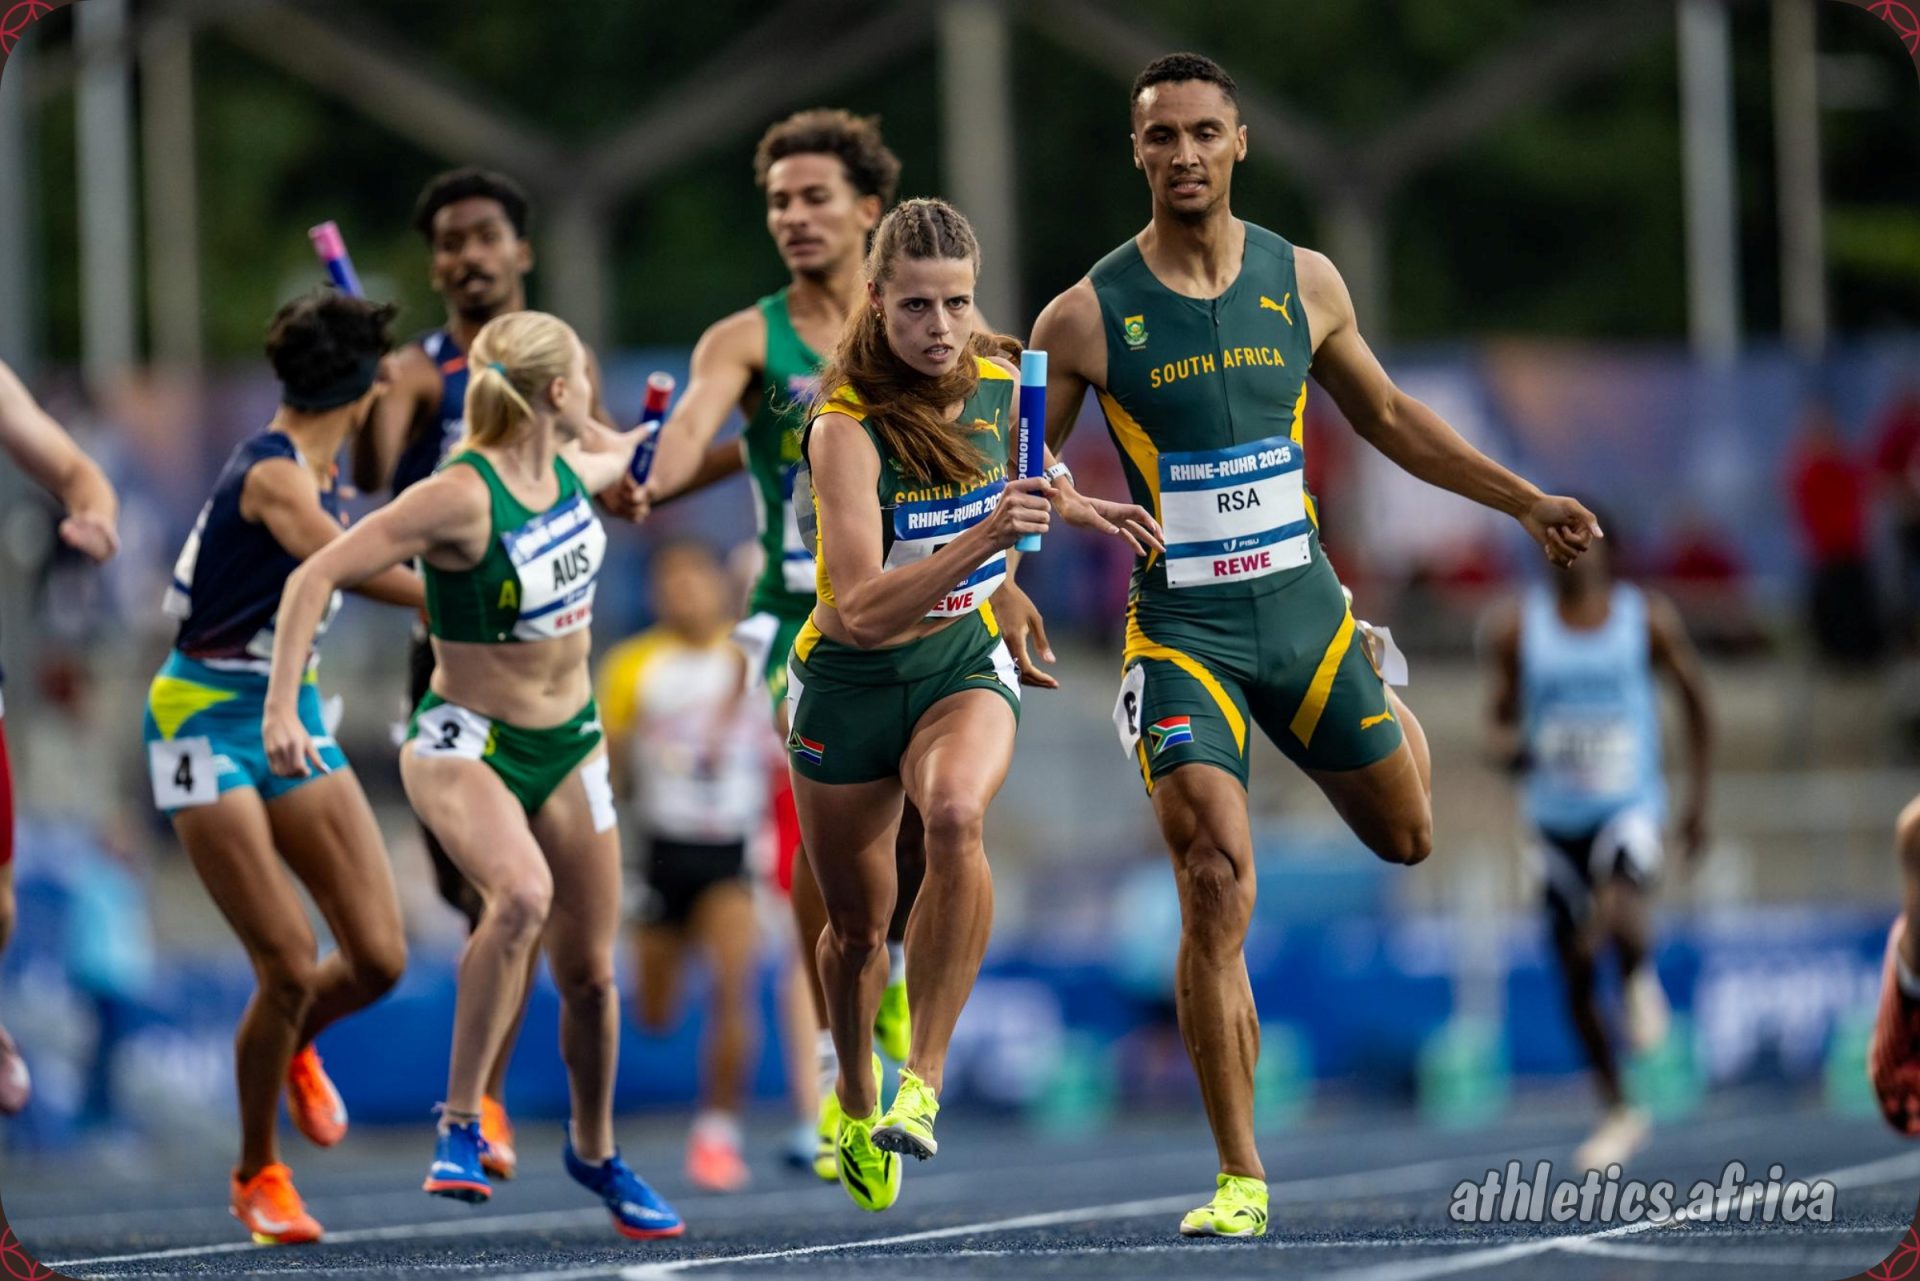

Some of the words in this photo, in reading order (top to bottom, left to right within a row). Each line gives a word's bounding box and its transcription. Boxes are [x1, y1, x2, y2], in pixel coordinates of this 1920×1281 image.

[1150, 353, 1216, 389] SOUTH
[1223, 347, 1285, 369] AFRICA
[1170, 455, 1257, 481] RHINE-RUHR
[1258, 446, 1291, 469] 2025
[908, 500, 983, 529] RHINE-RUHR
[1216, 488, 1261, 514] RSA
[553, 543, 590, 591] AUS
[1213, 551, 1272, 577] REWE
[932, 591, 974, 611] EWE
[174, 752, 194, 794] 4
